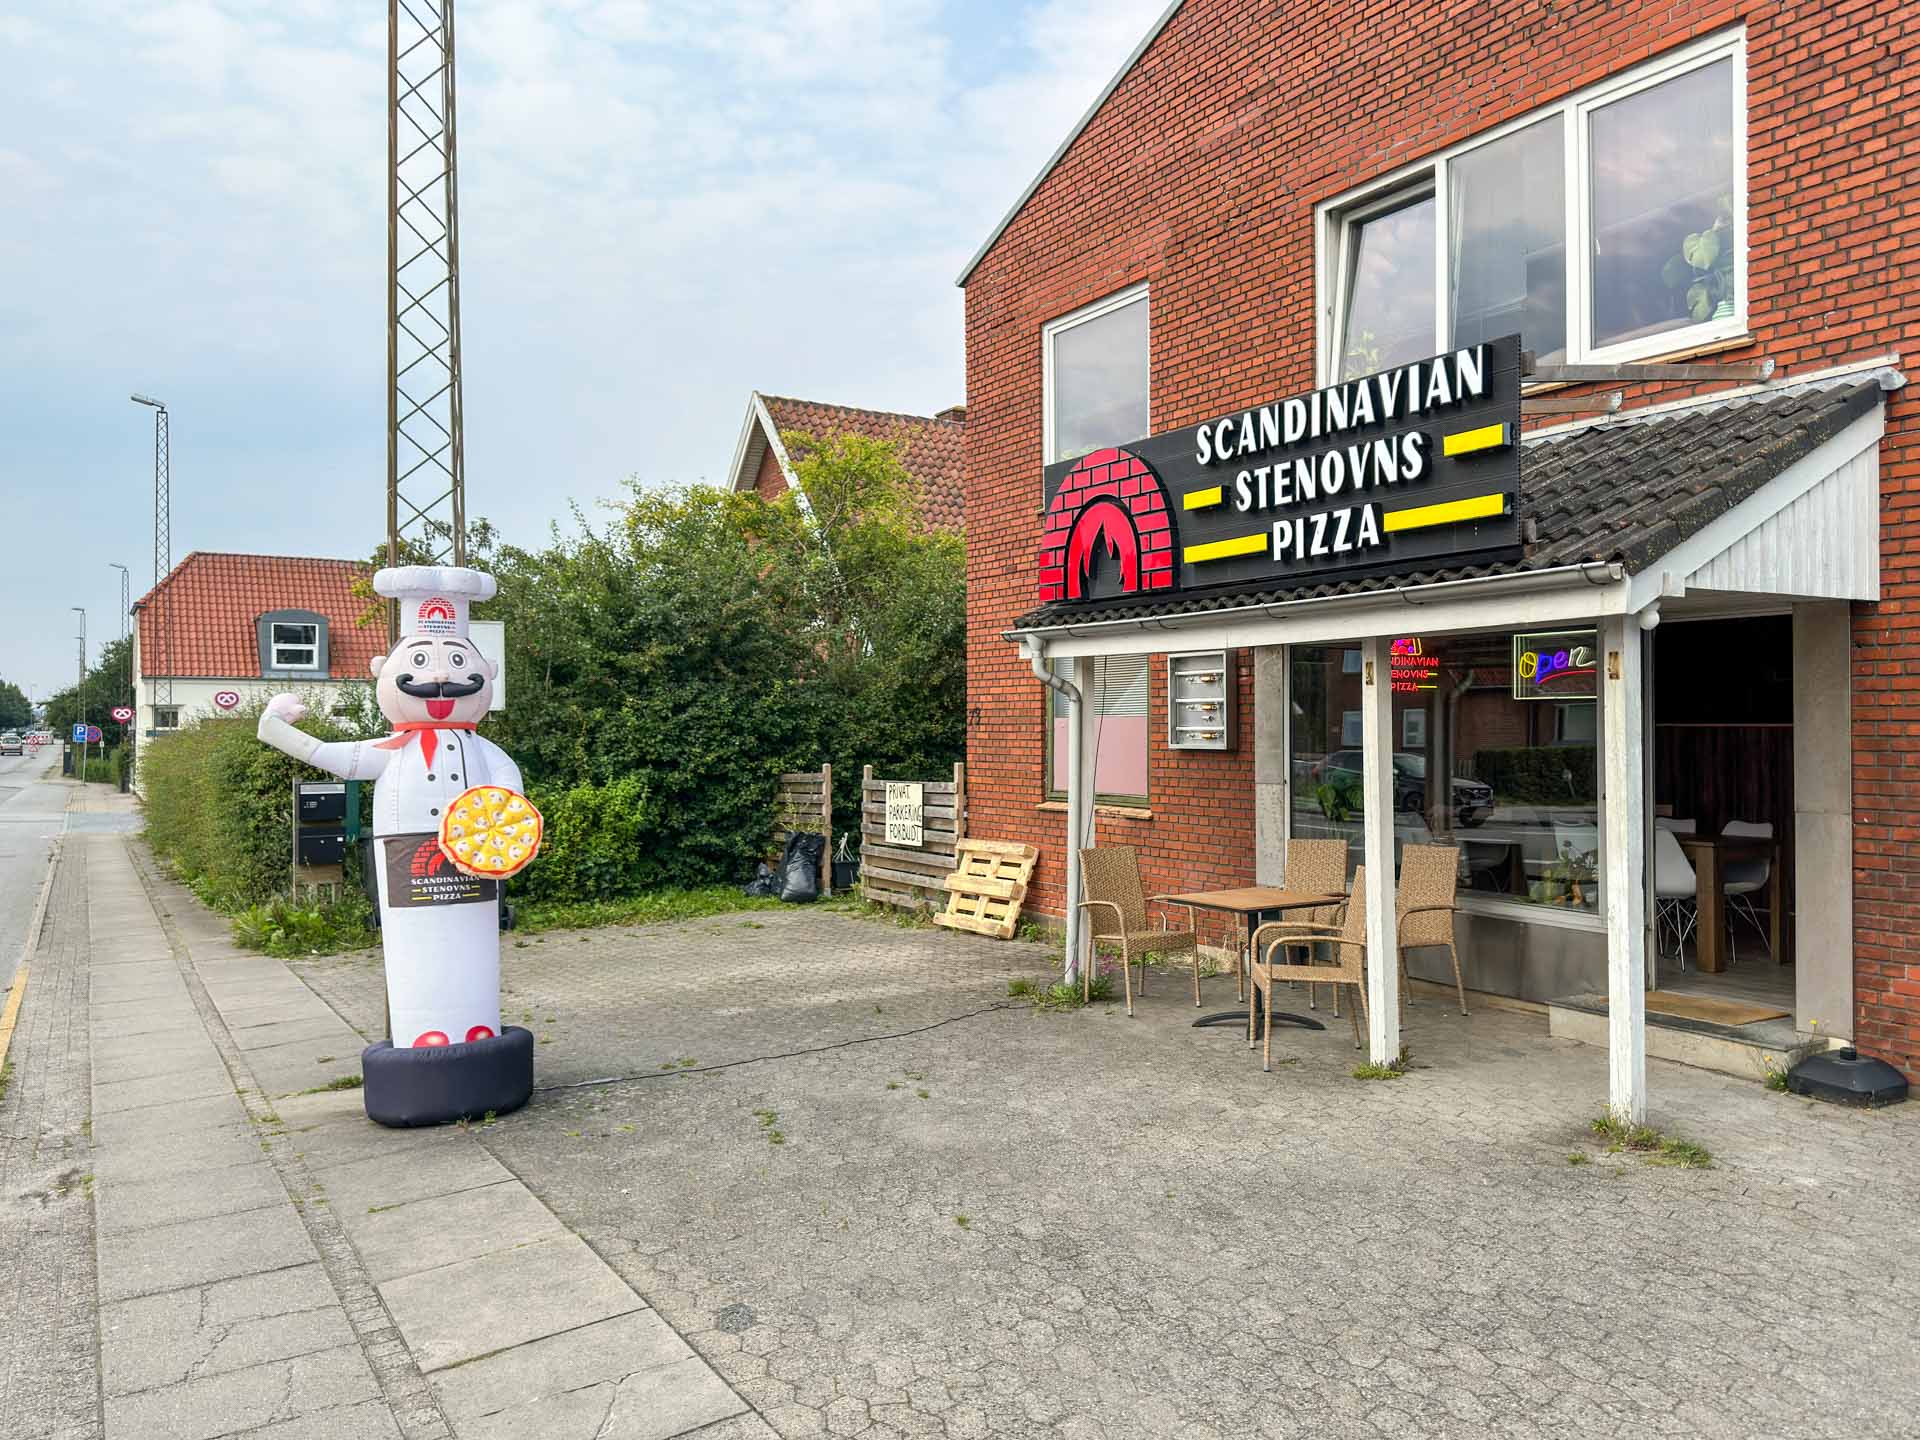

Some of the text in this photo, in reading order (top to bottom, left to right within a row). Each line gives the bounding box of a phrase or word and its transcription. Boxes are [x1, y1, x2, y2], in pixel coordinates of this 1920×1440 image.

[1195, 344, 1485, 465] SCANDINAVIAN
[1235, 431, 1424, 512] STENOVNS
[1272, 504, 1380, 561] PIZZA
[76, 726, 84, 735] P
[888, 784, 911, 799] PRIVAT
[888, 804, 922, 822] PARKERING
[889, 824, 922, 842] FORBUDT
[422, 885, 471, 893] STENOVNS
[432, 893, 461, 901] PIZZA
